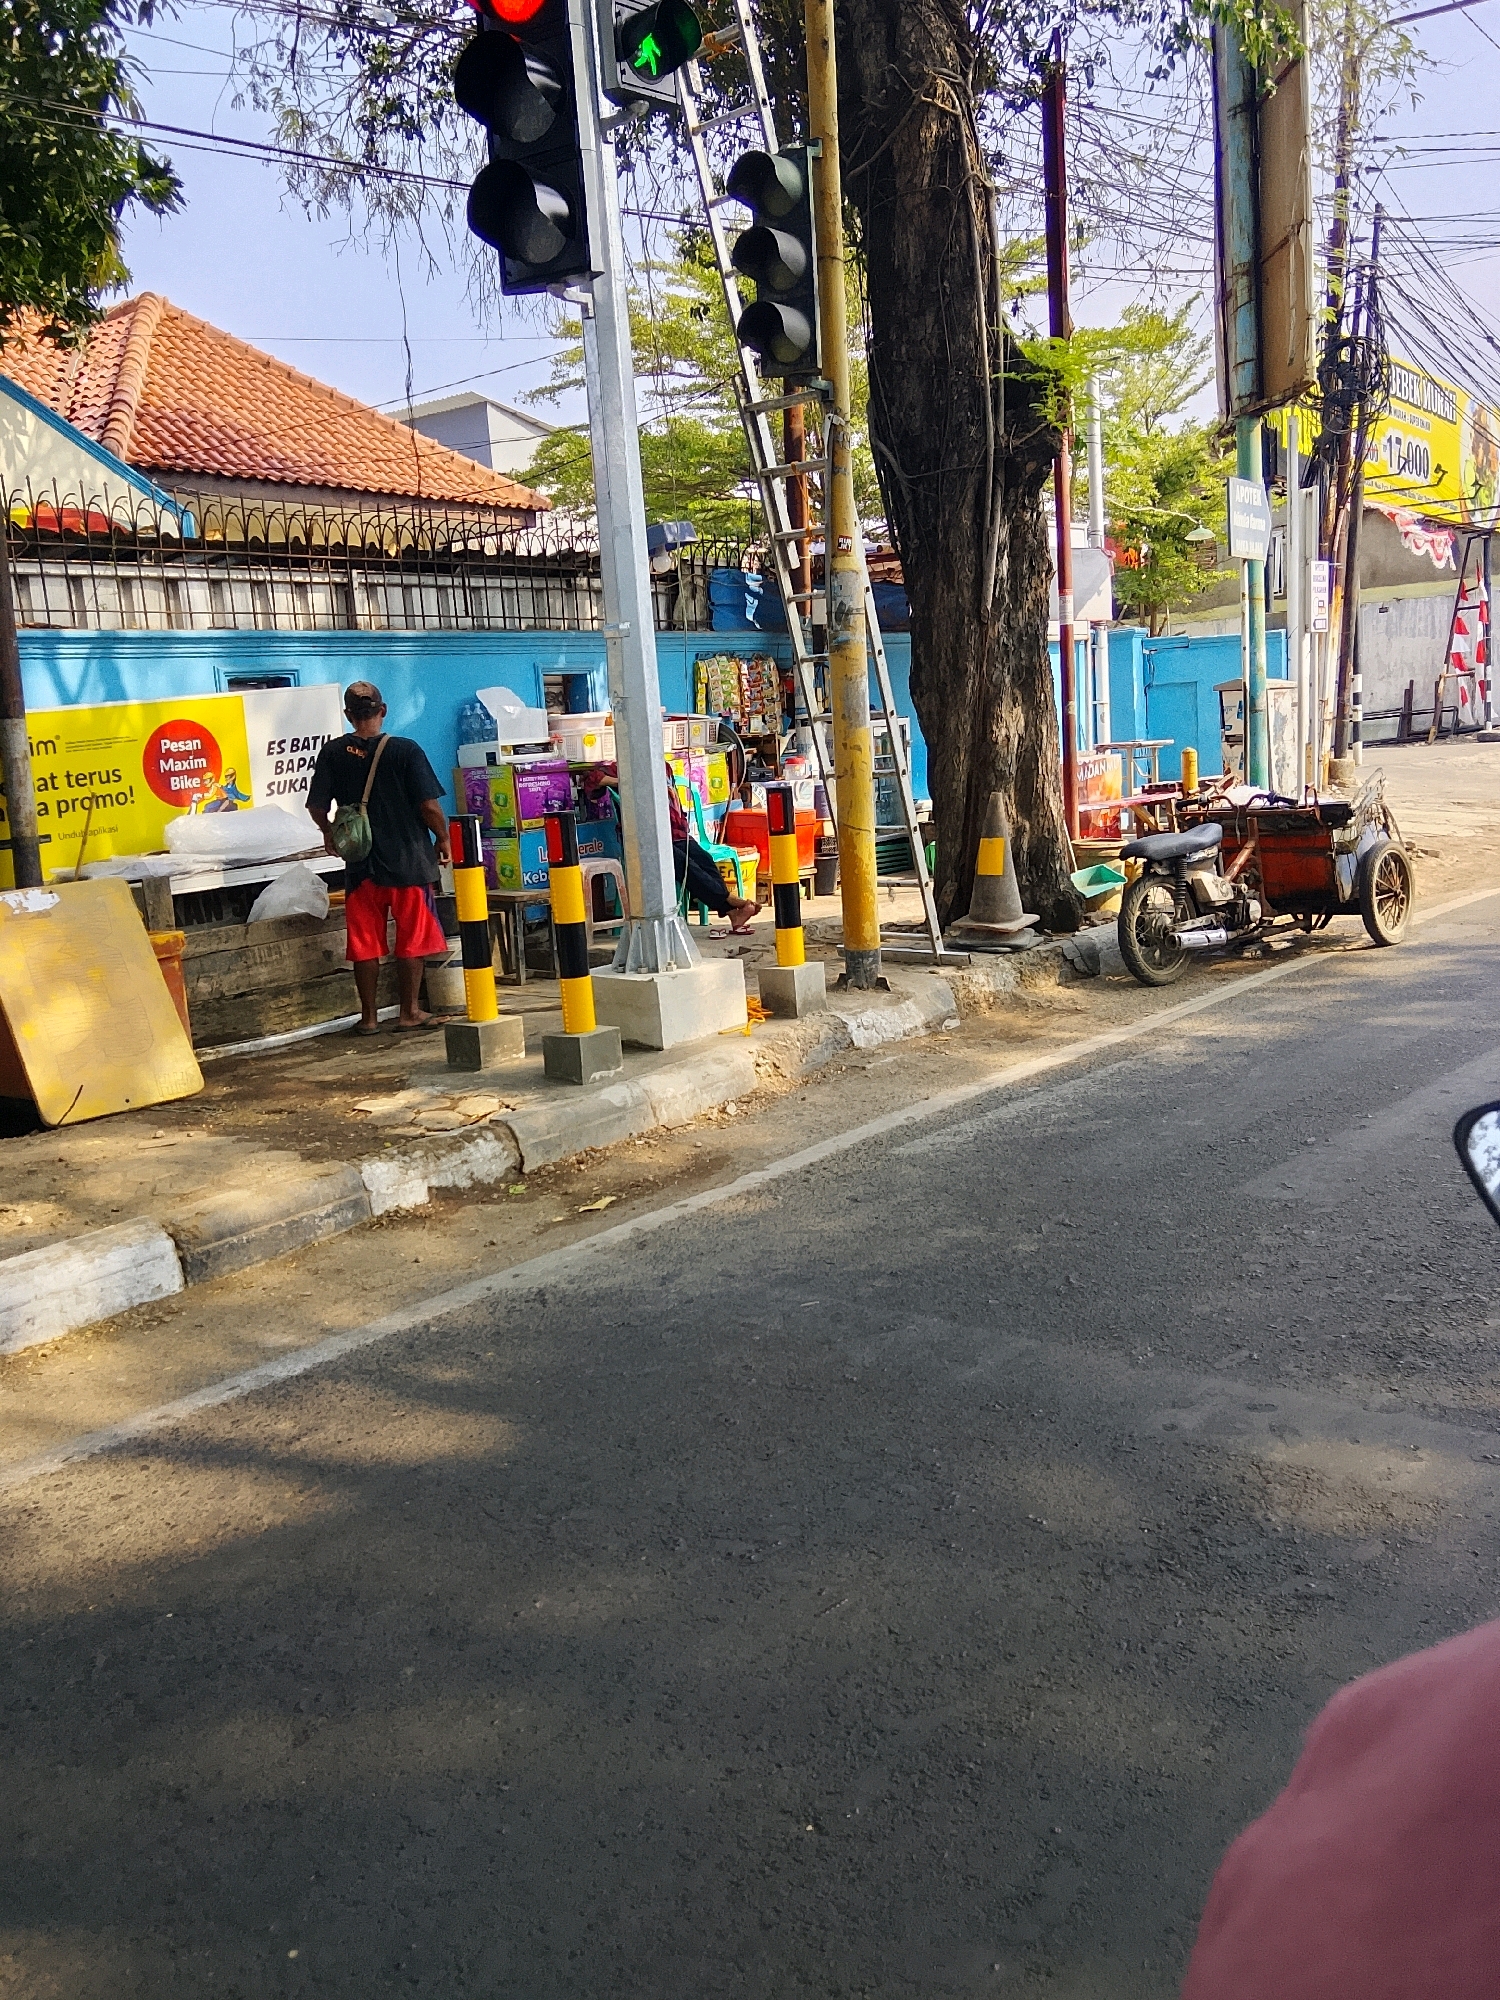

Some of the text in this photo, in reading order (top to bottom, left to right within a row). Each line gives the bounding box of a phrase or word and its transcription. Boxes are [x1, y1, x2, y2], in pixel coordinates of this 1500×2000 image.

[1235, 484, 1263, 507] APOTEK
[160, 738, 202, 754] Pesan
[266, 739, 287, 756] ES
[159, 755, 208, 773] Maxim
[274, 755, 316, 775] BAPA
[64, 768, 122, 788] terus
[170, 775, 201, 791] Bike
[265, 776, 309, 797] SUKA
[56, 785, 135, 819] promo!
[87, 824, 119, 838] aplikasi
